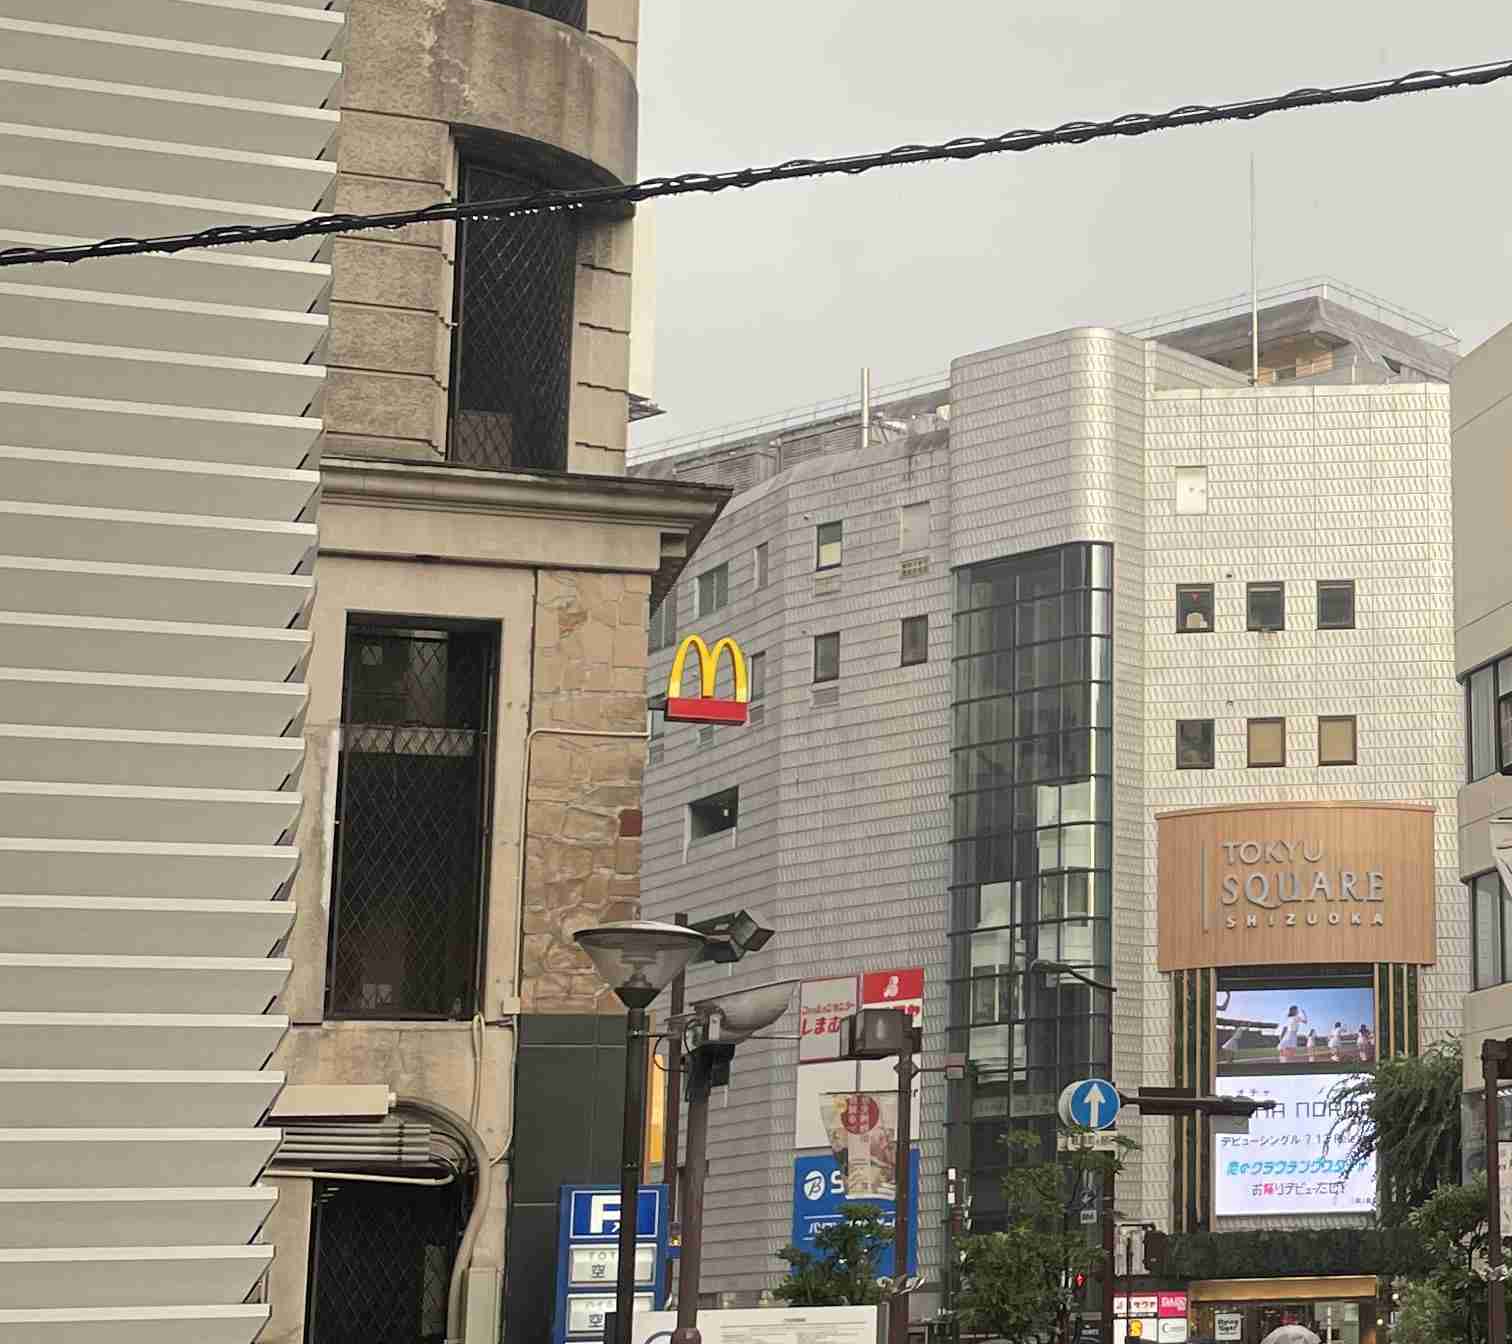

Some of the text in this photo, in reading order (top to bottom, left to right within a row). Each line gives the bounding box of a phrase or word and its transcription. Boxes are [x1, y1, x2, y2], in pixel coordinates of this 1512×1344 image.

[1222, 840, 1324, 865] TOKYU
[1221, 871, 1385, 909] SQUARE
[1226, 912, 1385, 929] SHIZUOKA
